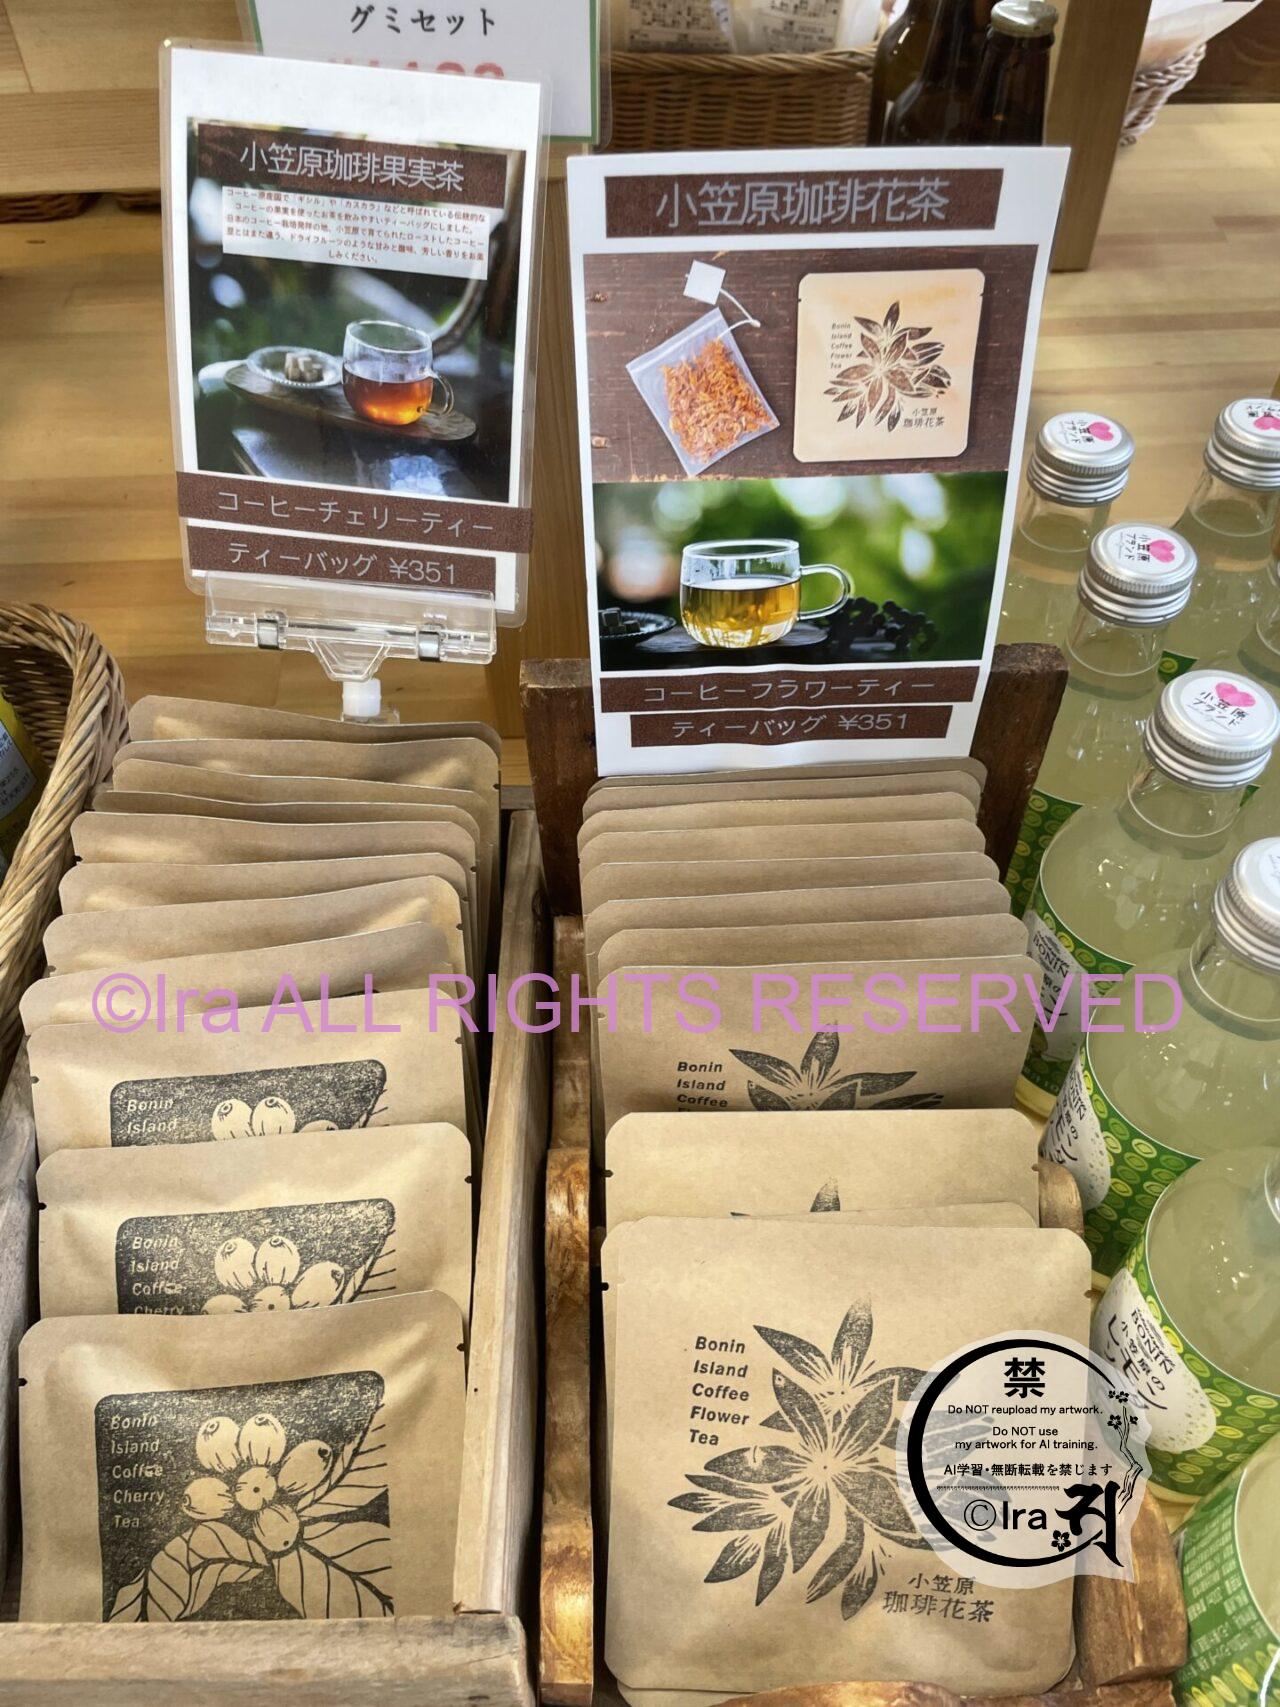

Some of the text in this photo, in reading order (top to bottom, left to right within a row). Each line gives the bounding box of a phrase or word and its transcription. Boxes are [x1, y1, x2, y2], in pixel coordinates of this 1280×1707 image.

[350, 4, 495, 36] グミセット
[240, 140, 465, 192] 小笠原珈琲果実茶
[656, 176, 950, 228] 小笠原珈琲花茶
[912, 407, 938, 417] 小笠原
[903, 416, 945, 428] 珈琲花茶
[218, 491, 494, 538] コーヒーチェリーティー
[228, 542, 456, 585] ティーバッグ ¥351
[644, 678, 935, 703] コーヒーフラワーティー
[671, 713, 908, 739] ティーバッグ ¥351
[677, 1061, 723, 1073] Bonin
[677, 1078, 726, 1091] Island
[127, 1098, 174, 1113] Bonin
[677, 1094, 728, 1108] Coffee
[127, 1118, 178, 1135] Island
[132, 1235, 178, 1250] Bonin
[130, 1259, 180, 1274] Island
[132, 1281, 183, 1296] Coffee
[695, 1336, 746, 1354] Bonin
[1131, 1308, 1173, 1375] BONIN
[693, 1359, 749, 1378] Island
[692, 1382, 750, 1402] Coffee
[111, 1413, 159, 1431] Bonin
[690, 1405, 750, 1426] Flower
[689, 1428, 719, 1446] Tea
[110, 1439, 160, 1454] Island
[112, 1463, 164, 1479] Coffee
[113, 1489, 165, 1506] Cherry
[114, 1514, 140, 1529] Tea
[908, 1573, 975, 1596] 小笠原
[883, 1590, 994, 1622] 珈琲花茶
